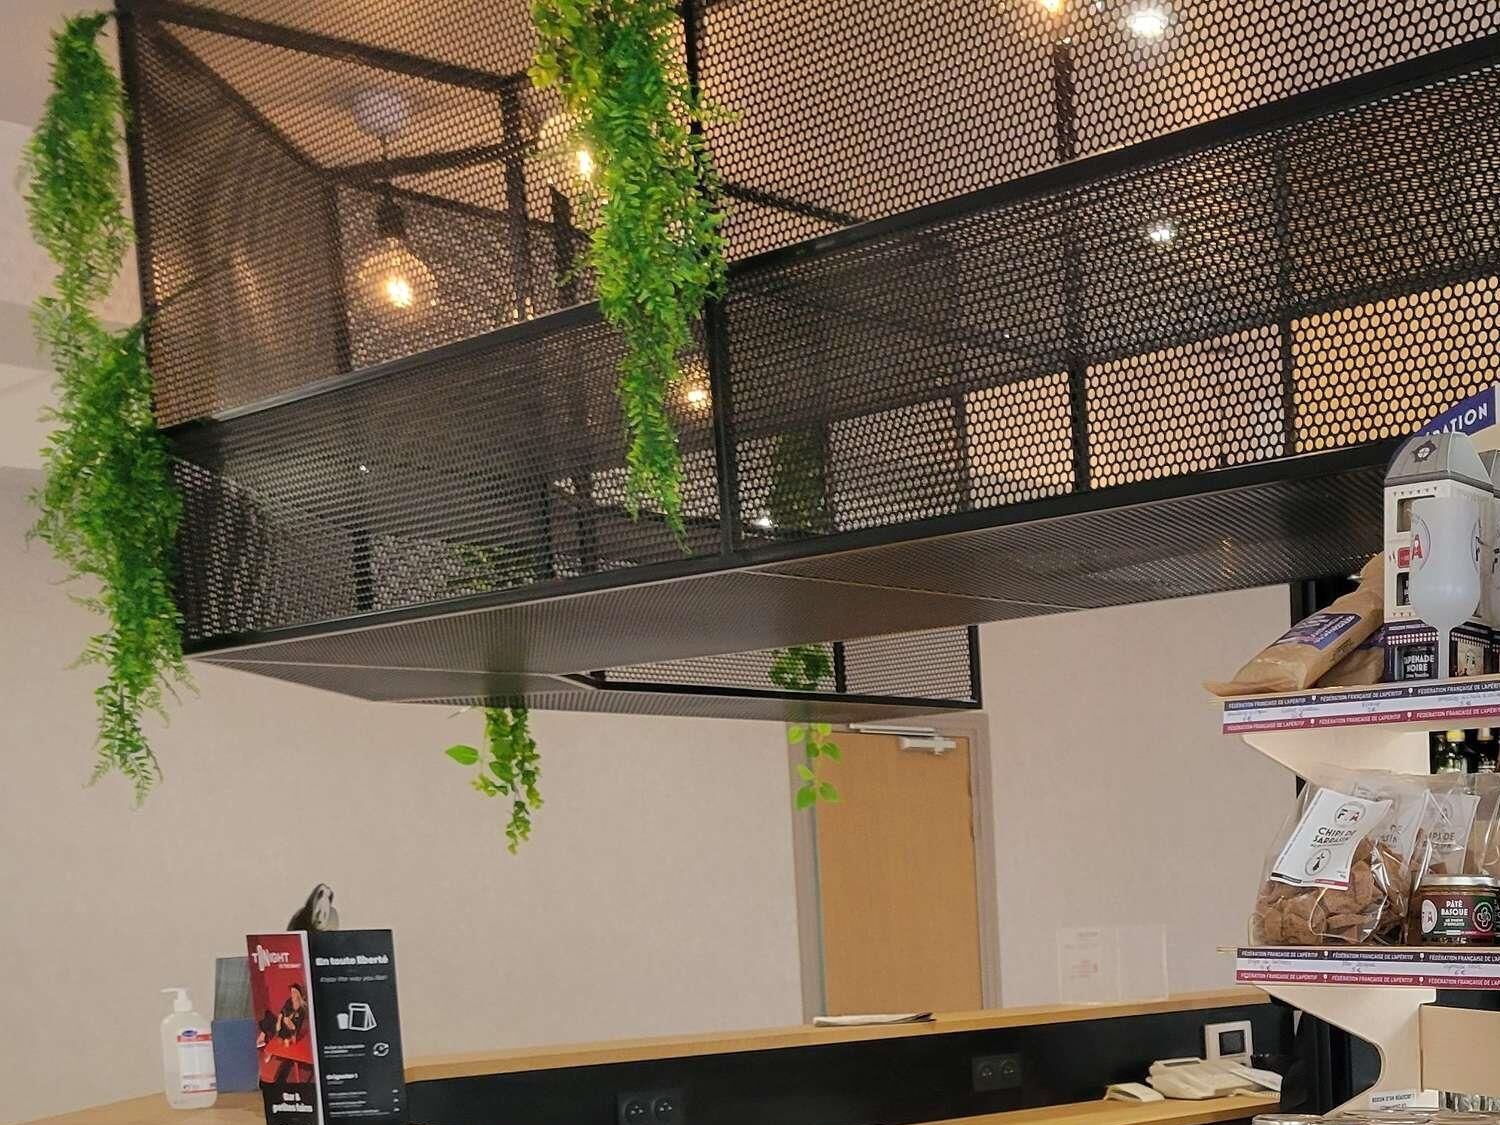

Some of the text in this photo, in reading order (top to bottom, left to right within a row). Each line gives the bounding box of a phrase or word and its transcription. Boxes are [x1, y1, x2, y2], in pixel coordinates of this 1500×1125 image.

[1446, 899, 1463, 908] PÂTÉ
[1440, 908, 1469, 916] BASQUE
[356, 954, 389, 964] liberté
